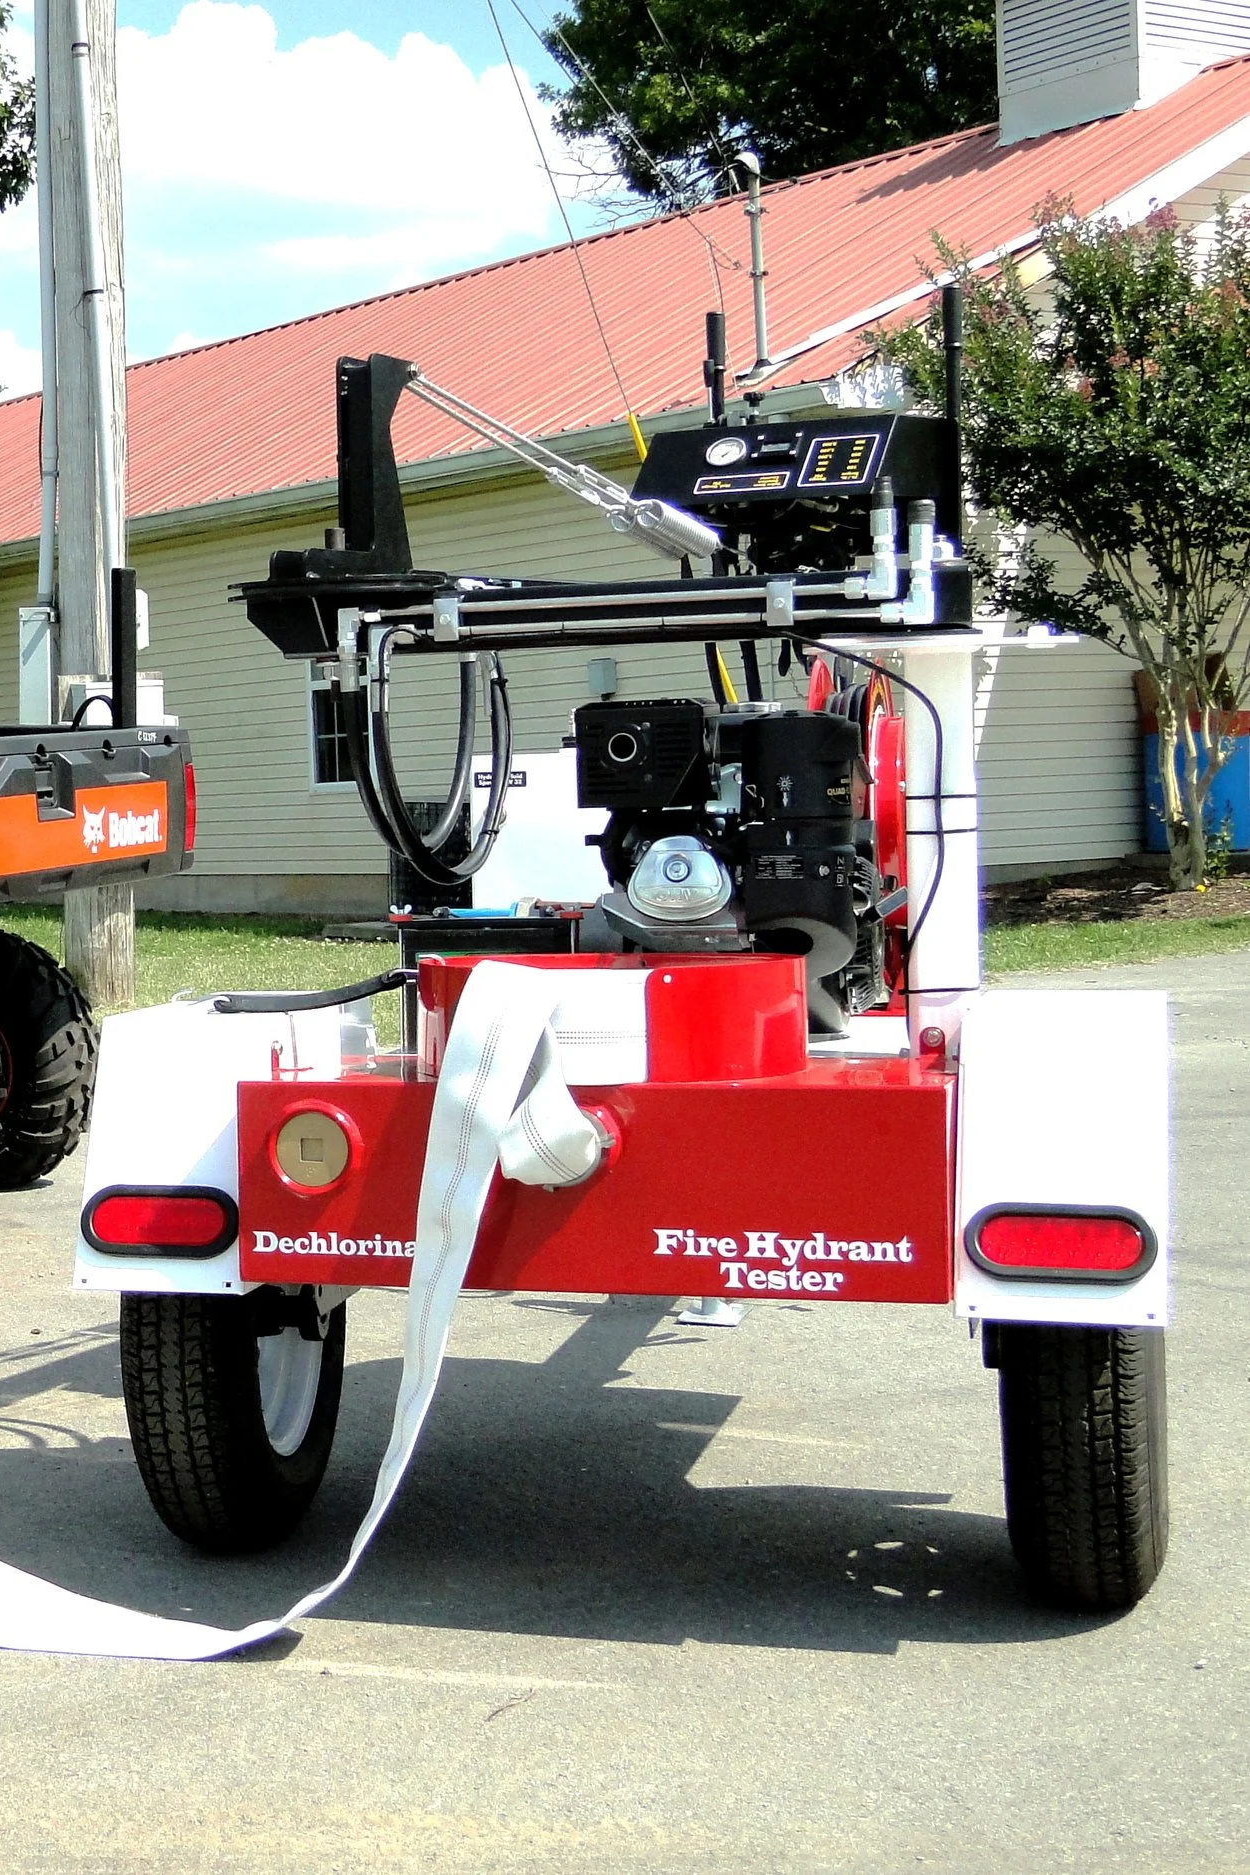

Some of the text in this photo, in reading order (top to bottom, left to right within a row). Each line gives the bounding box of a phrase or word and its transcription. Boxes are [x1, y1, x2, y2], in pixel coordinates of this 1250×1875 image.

[108, 808, 161, 848] Bobcat
[653, 1228, 913, 1266] Fire Hydrant
[719, 1262, 844, 1292] Tester
